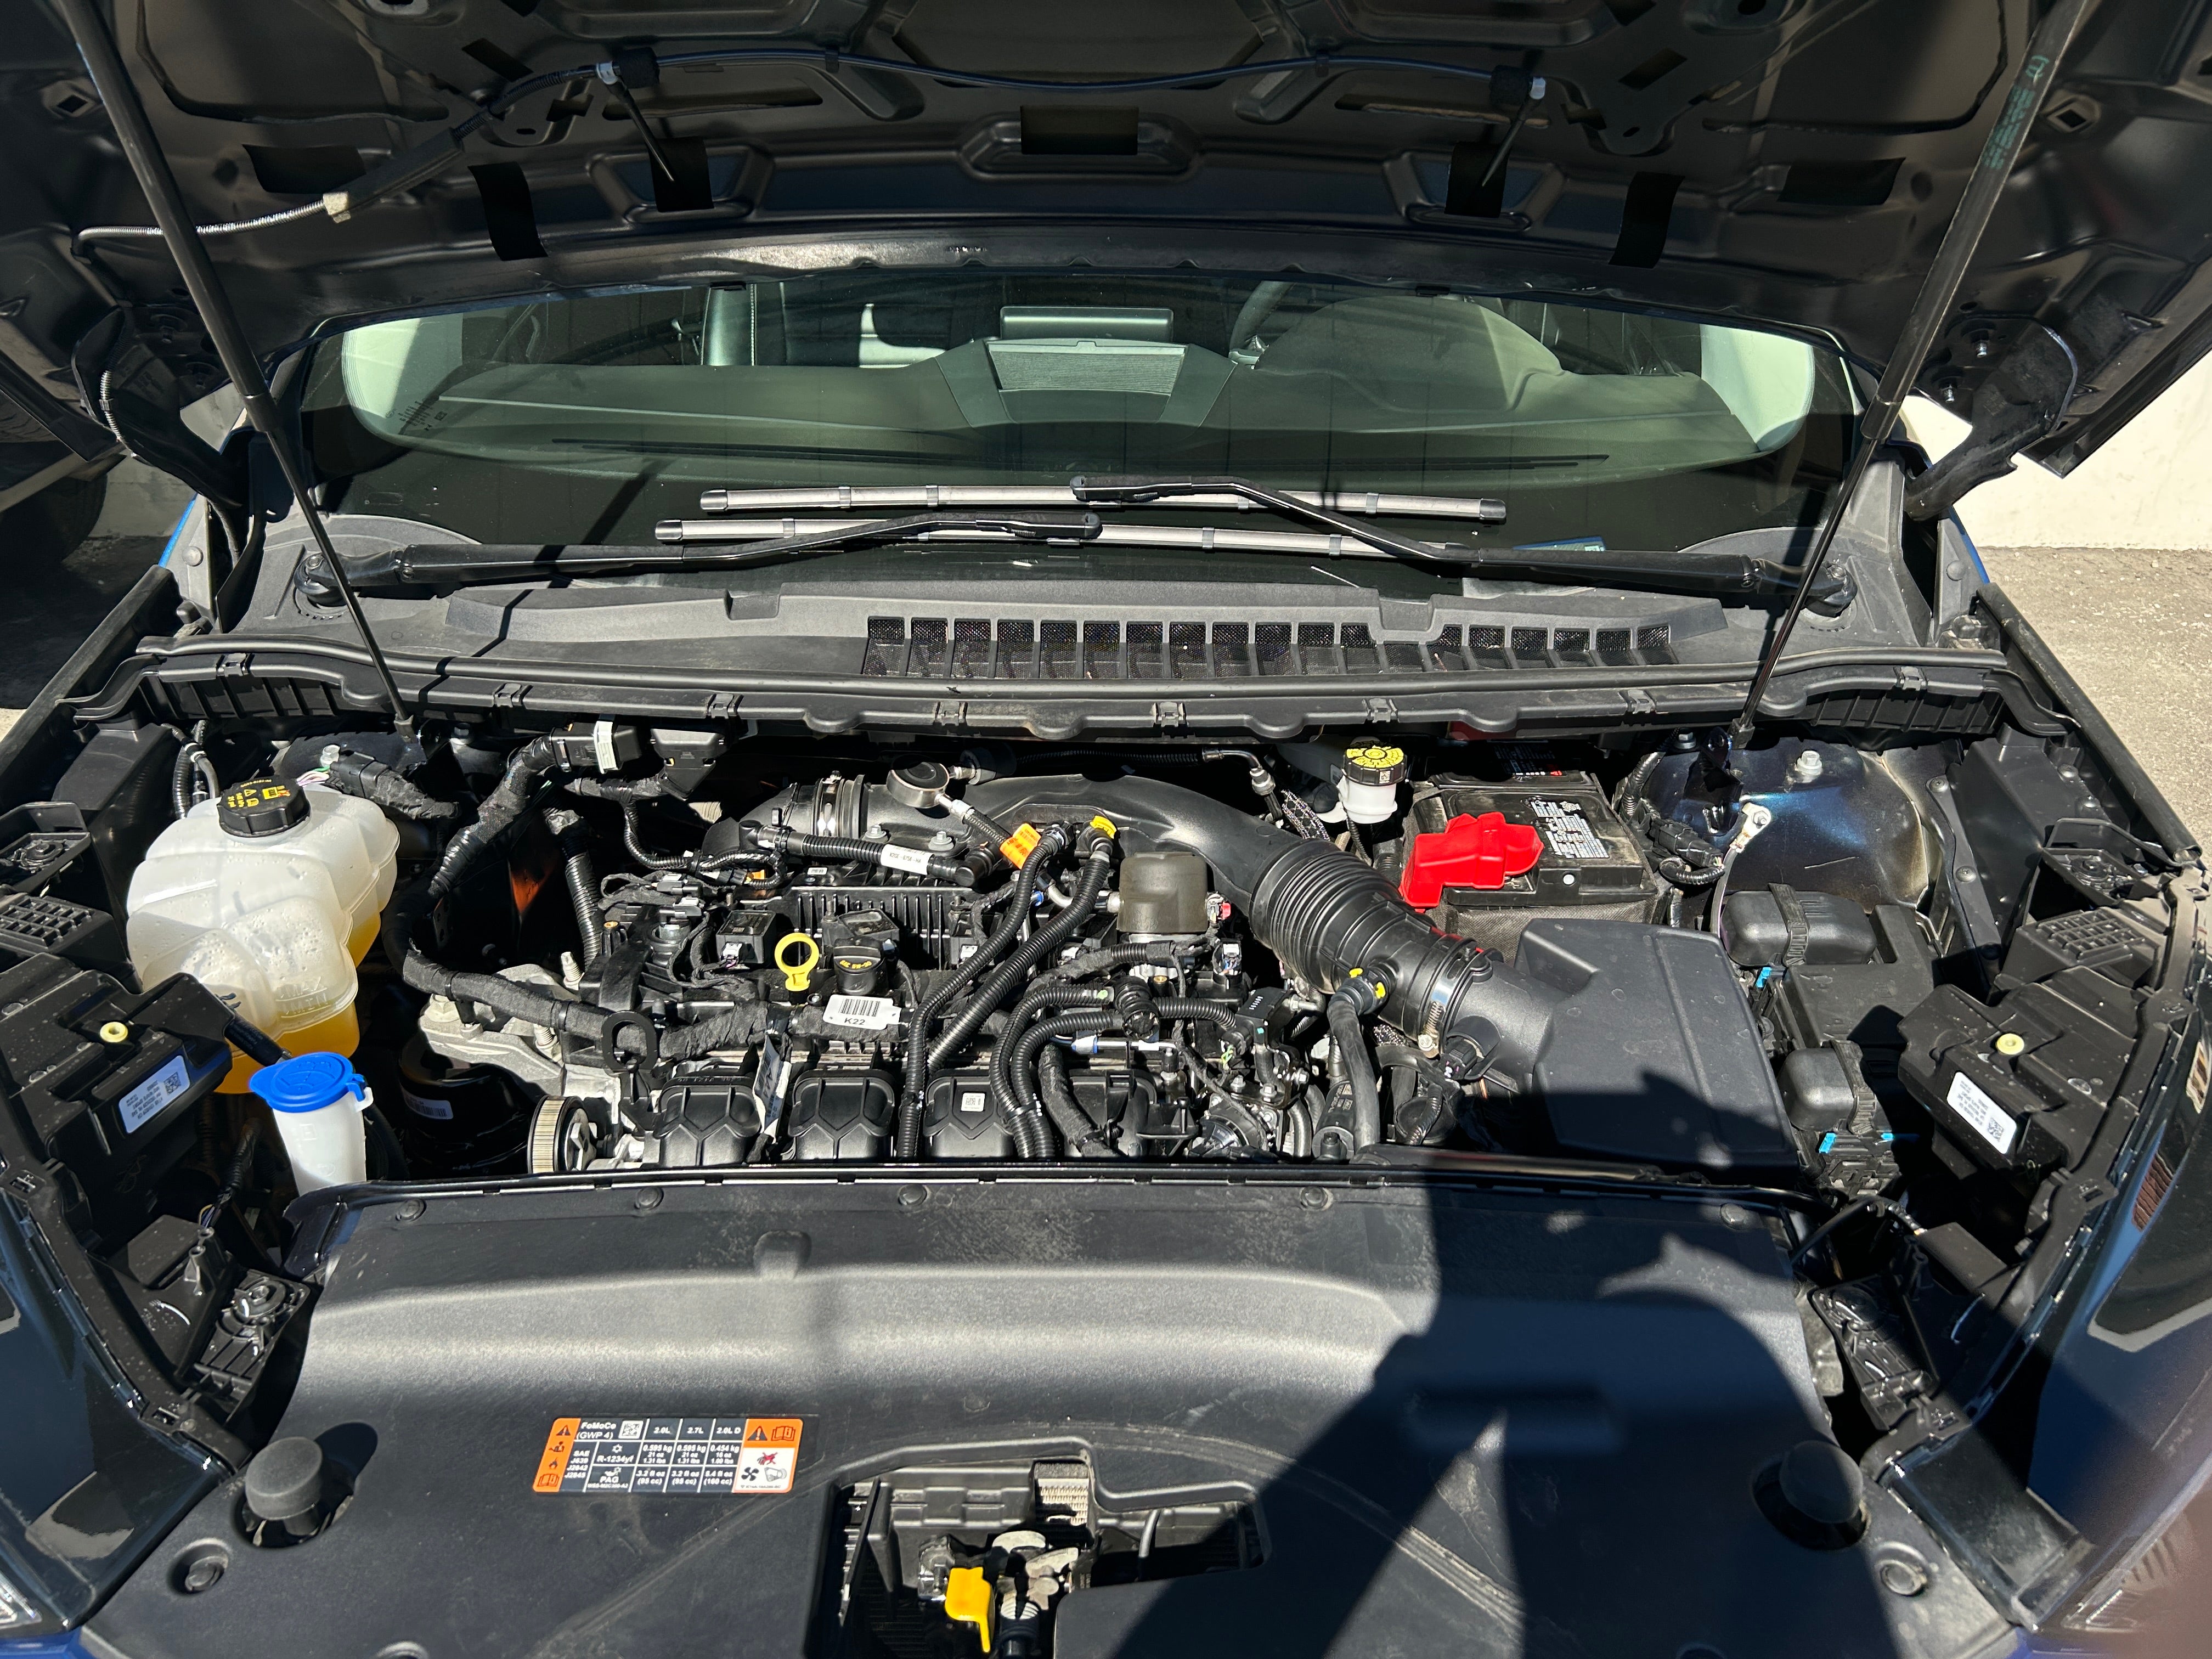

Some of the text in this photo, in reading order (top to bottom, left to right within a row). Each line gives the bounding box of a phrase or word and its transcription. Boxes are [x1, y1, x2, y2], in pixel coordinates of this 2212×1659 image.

[844, 1017, 866, 1025] K22
[580, 1421, 617, 1430] FoMoCo
[576, 1431, 613, 1440] (GWP 4)
[663, 1444, 673, 1453] kg
[697, 1444, 707, 1453] kg
[730, 1444, 740, 1453] kg
[596, 1455, 634, 1464] R-1234yf
